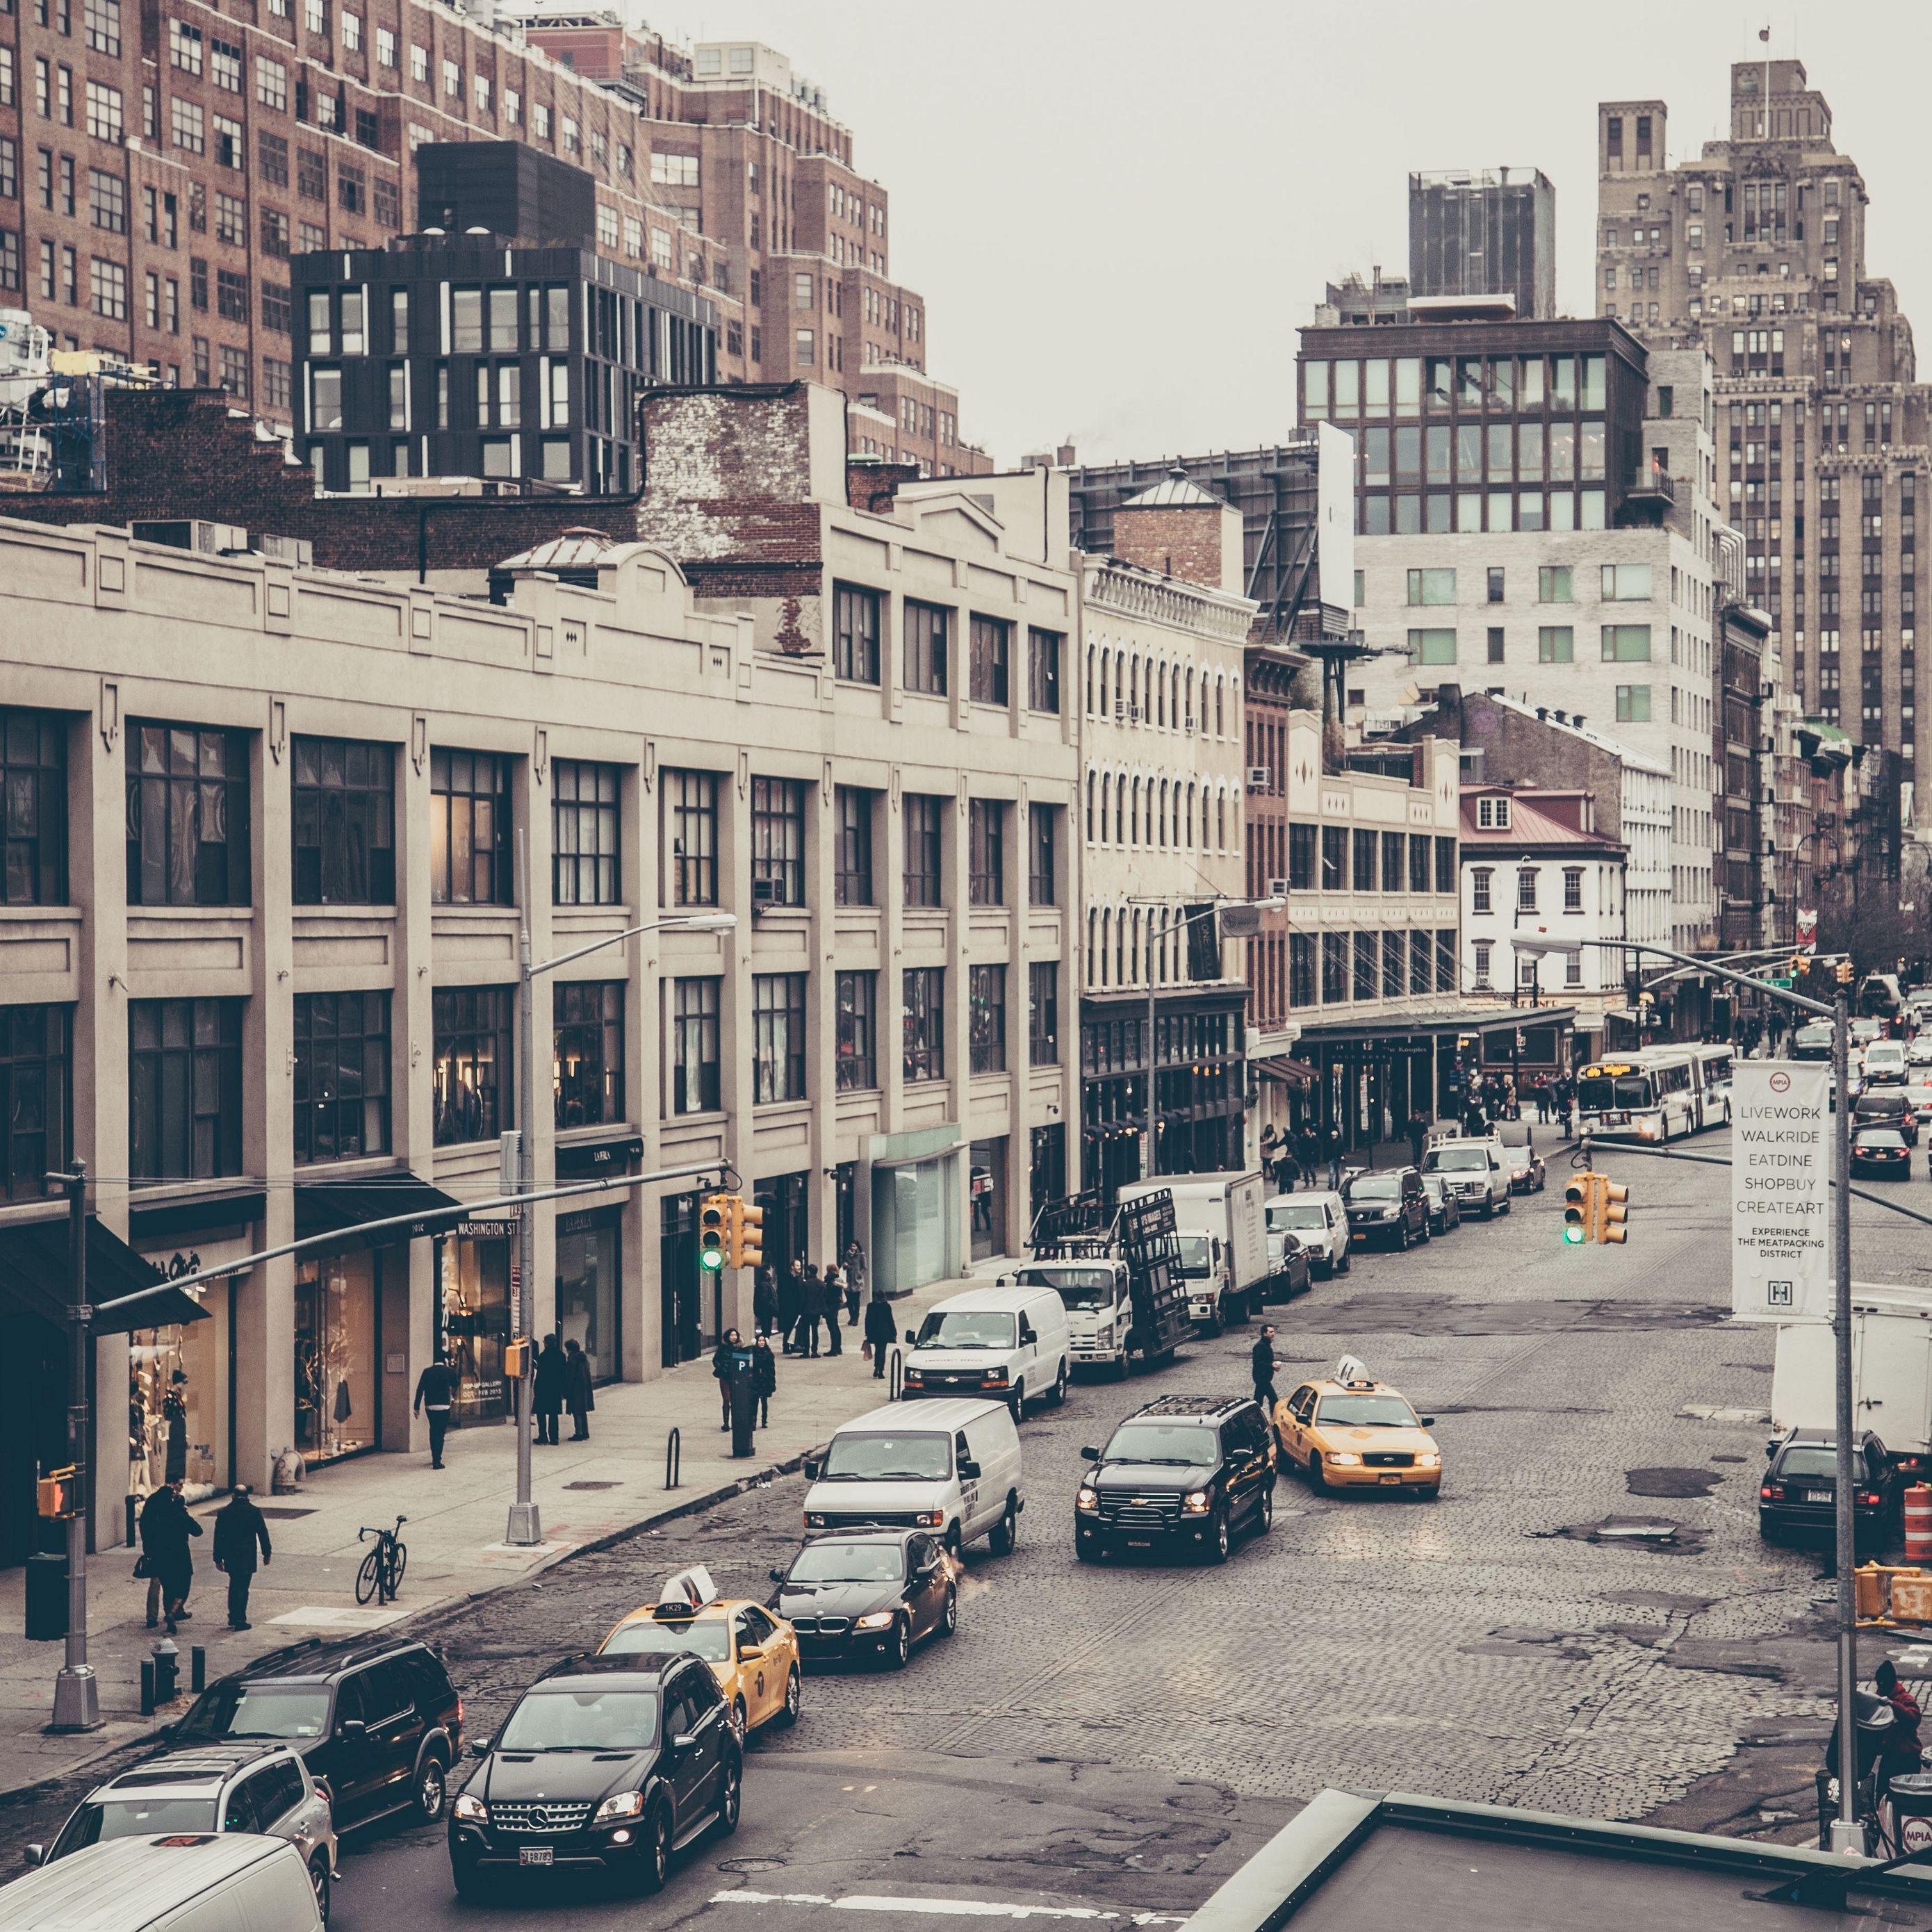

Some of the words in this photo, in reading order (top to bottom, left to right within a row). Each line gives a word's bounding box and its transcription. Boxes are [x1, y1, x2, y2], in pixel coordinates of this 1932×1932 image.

[1741, 1106, 1821, 1120] LIVEWORK
[1741, 1130, 1820, 1143] WALKRIDE
[1749, 1154, 1812, 1167] EATDINE
[1745, 1177, 1817, 1190] SHOPBUY
[1737, 1201, 1824, 1215] CREATEART
[458, 1222, 504, 1236] WASHINGTON
[507, 1222, 516, 1235] ST
[1752, 1227, 1810, 1237] EXPERIENCE
[1737, 1238, 1755, 1246] THE
[1758, 1238, 1824, 1248] MEATPACKING
[1760, 1250, 1802, 1259] DISTRICT
[739, 1361, 746, 1371] P
[1906, 1831, 1932, 1842] MPIA
